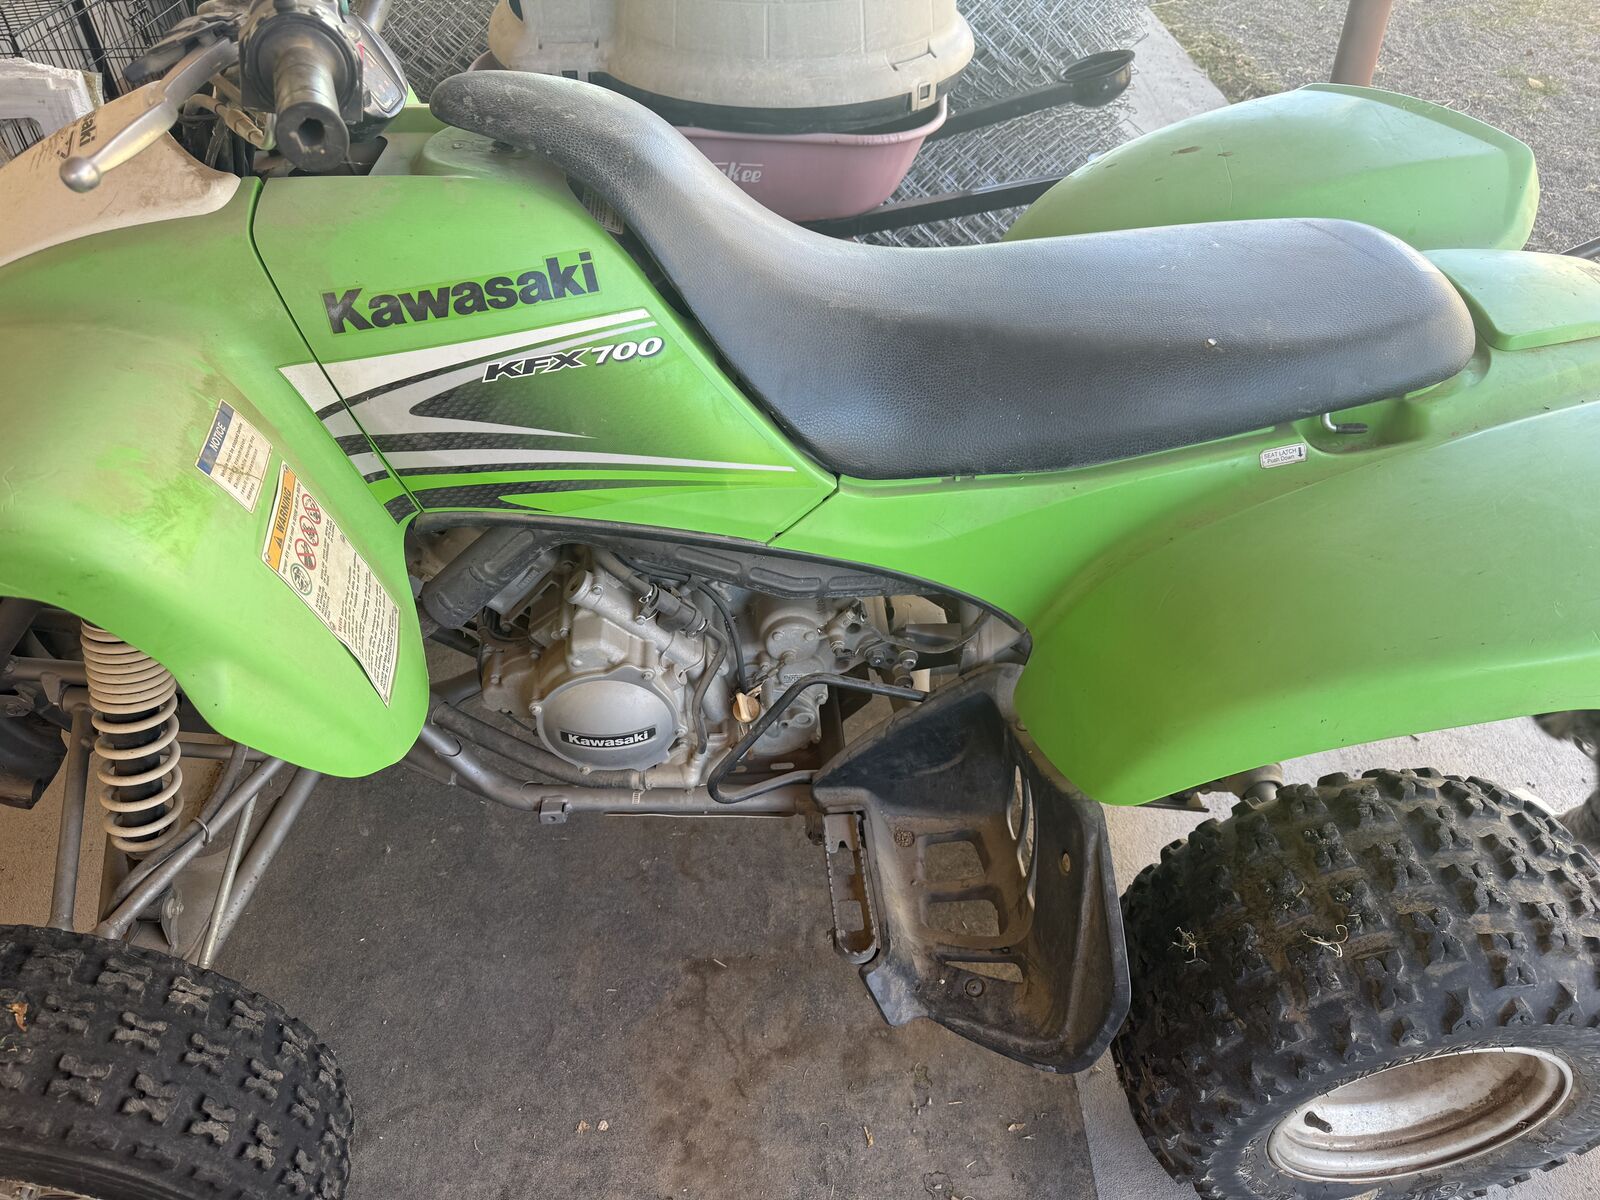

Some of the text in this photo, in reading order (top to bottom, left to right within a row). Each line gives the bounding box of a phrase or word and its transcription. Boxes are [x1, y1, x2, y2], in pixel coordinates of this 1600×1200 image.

[322, 251, 600, 334] Kawasaki
[482, 336, 664, 383] KFX 700
[209, 422, 226, 452] NOTICE
[1264, 448, 1297, 460] SEAT LATCH
[276, 487, 292, 535] WARNING
[567, 730, 649, 747] Kawasaki
